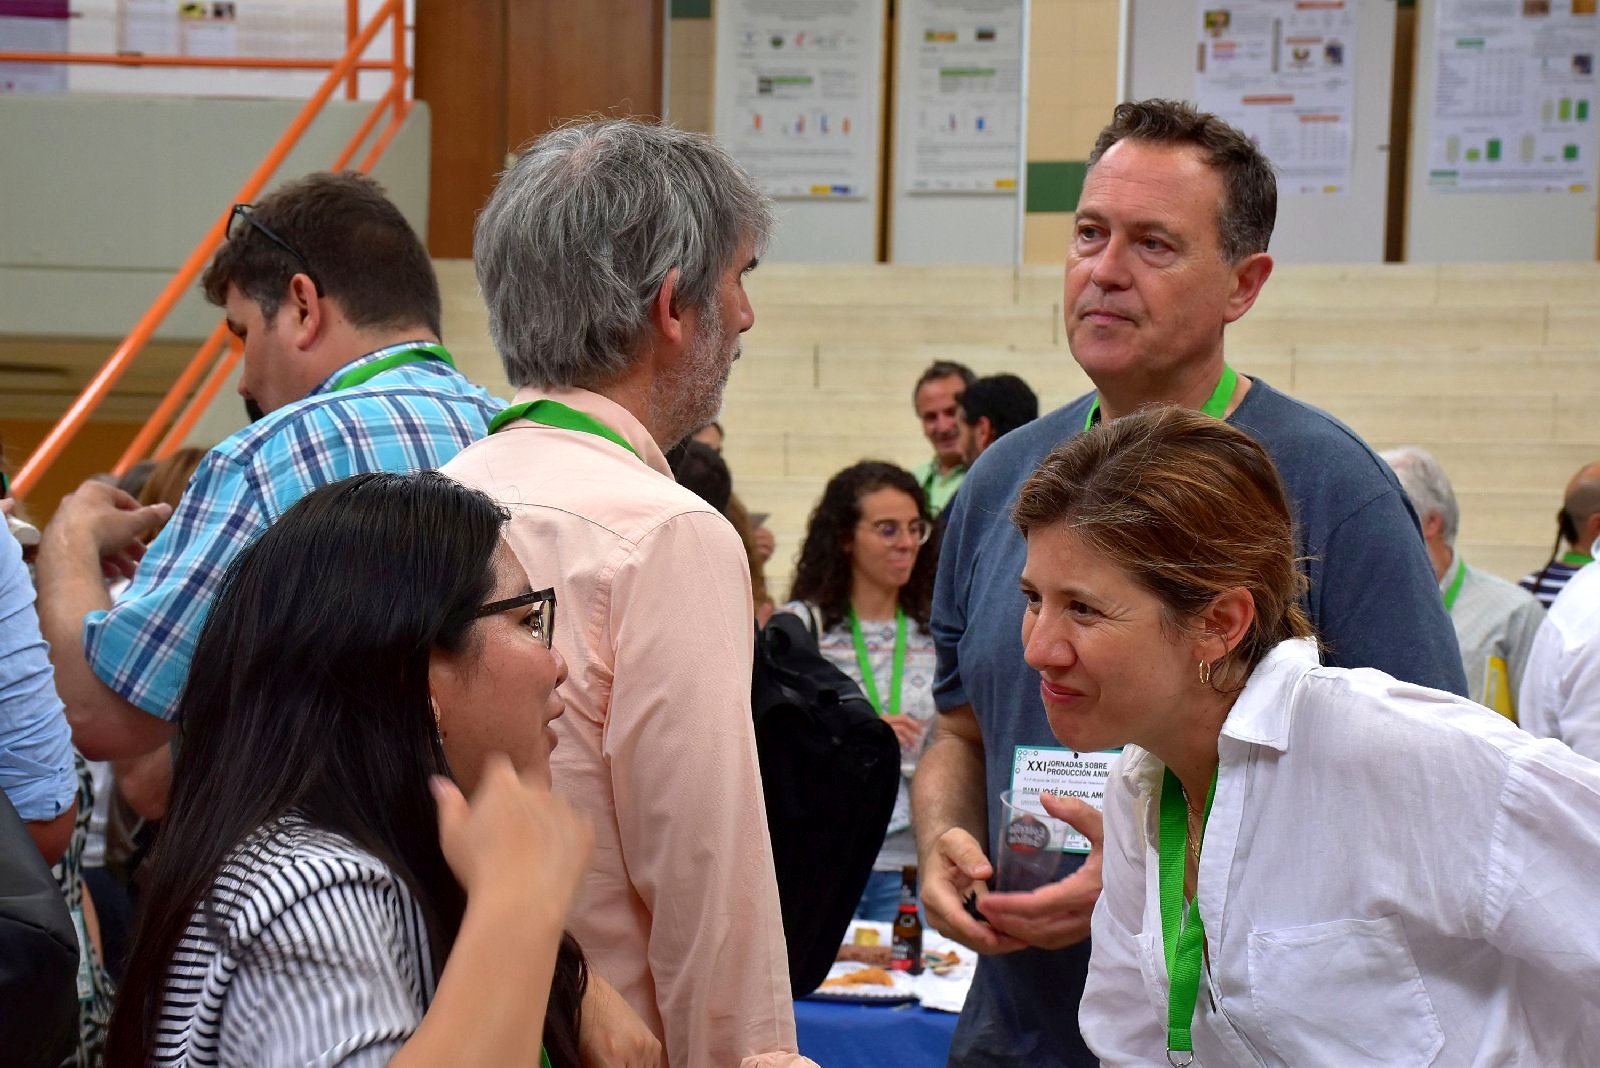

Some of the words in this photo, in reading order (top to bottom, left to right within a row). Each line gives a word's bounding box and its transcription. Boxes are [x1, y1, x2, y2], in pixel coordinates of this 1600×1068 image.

[1027, 760, 1047, 772] XXI
[1047, 760, 1083, 769] JORNADAS
[1084, 761, 1108, 770] SOBRE
[1046, 768, 1091, 777] PRODUCCIÓN
[1059, 789, 1090, 798] PASCUAL
